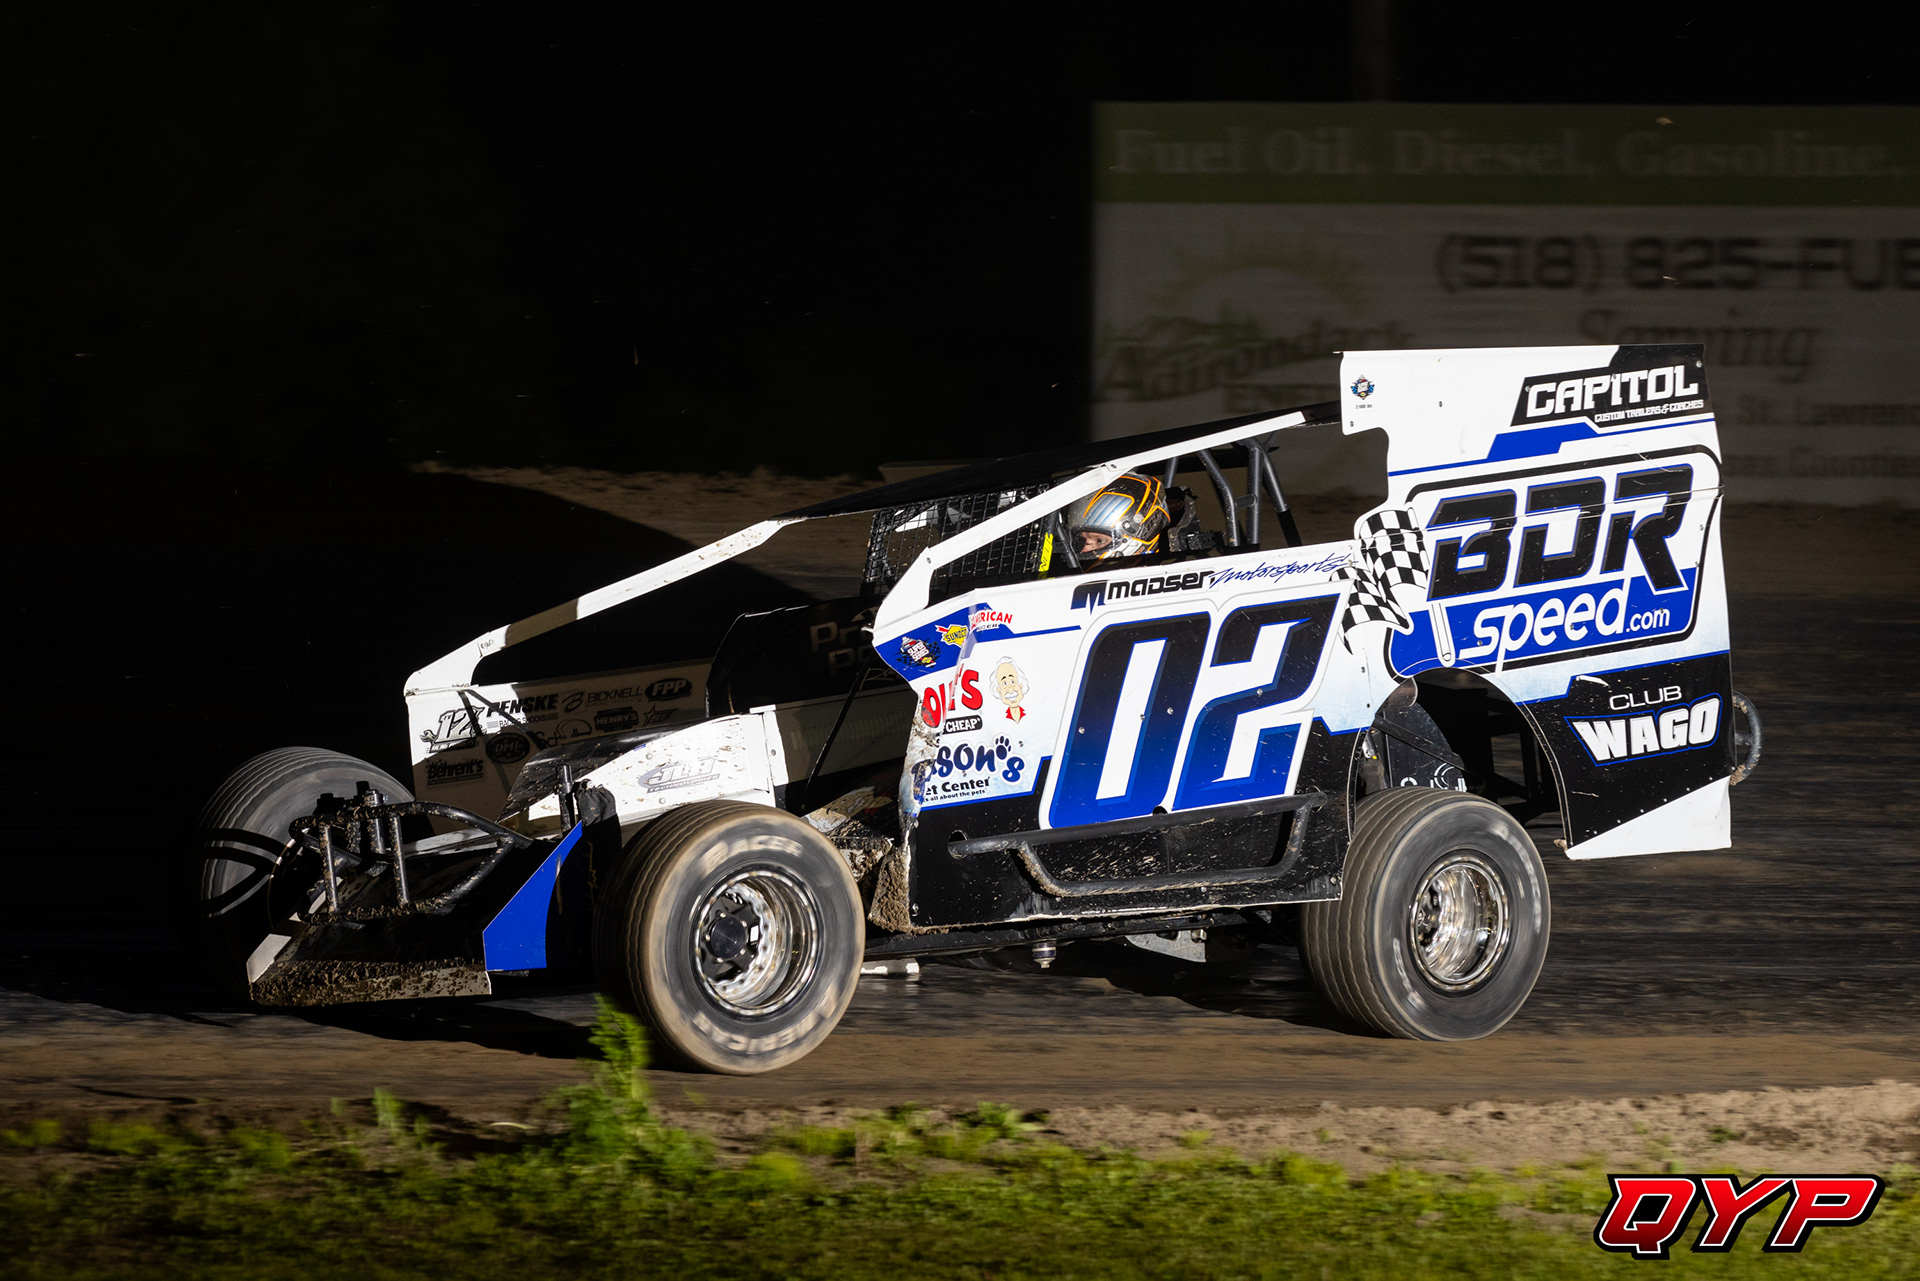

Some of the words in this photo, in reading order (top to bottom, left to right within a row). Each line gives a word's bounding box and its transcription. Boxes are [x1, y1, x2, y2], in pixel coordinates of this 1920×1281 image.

[1109, 126, 1245, 175] Fuel
[1434, 231, 1605, 297] (518)
[1526, 365, 1699, 418] CAPITOL
[1595, 410, 1626, 423] CUSTOM
[1625, 405, 1661, 418] TRAILERS
[1669, 400, 1704, 412] COACHES
[1426, 463, 1694, 601] BDR
[970, 611, 1013, 628] RICAN
[588, 686, 643, 703] BICKNELL
[652, 680, 687, 697] FPP
[1609, 686, 1682, 711] CLUB
[487, 693, 559, 717] PENSKE
[1048, 593, 1341, 829] 02
[1573, 697, 1721, 762] WAGO
[925, 784, 938, 796] et
[941, 777, 990, 793] Center
